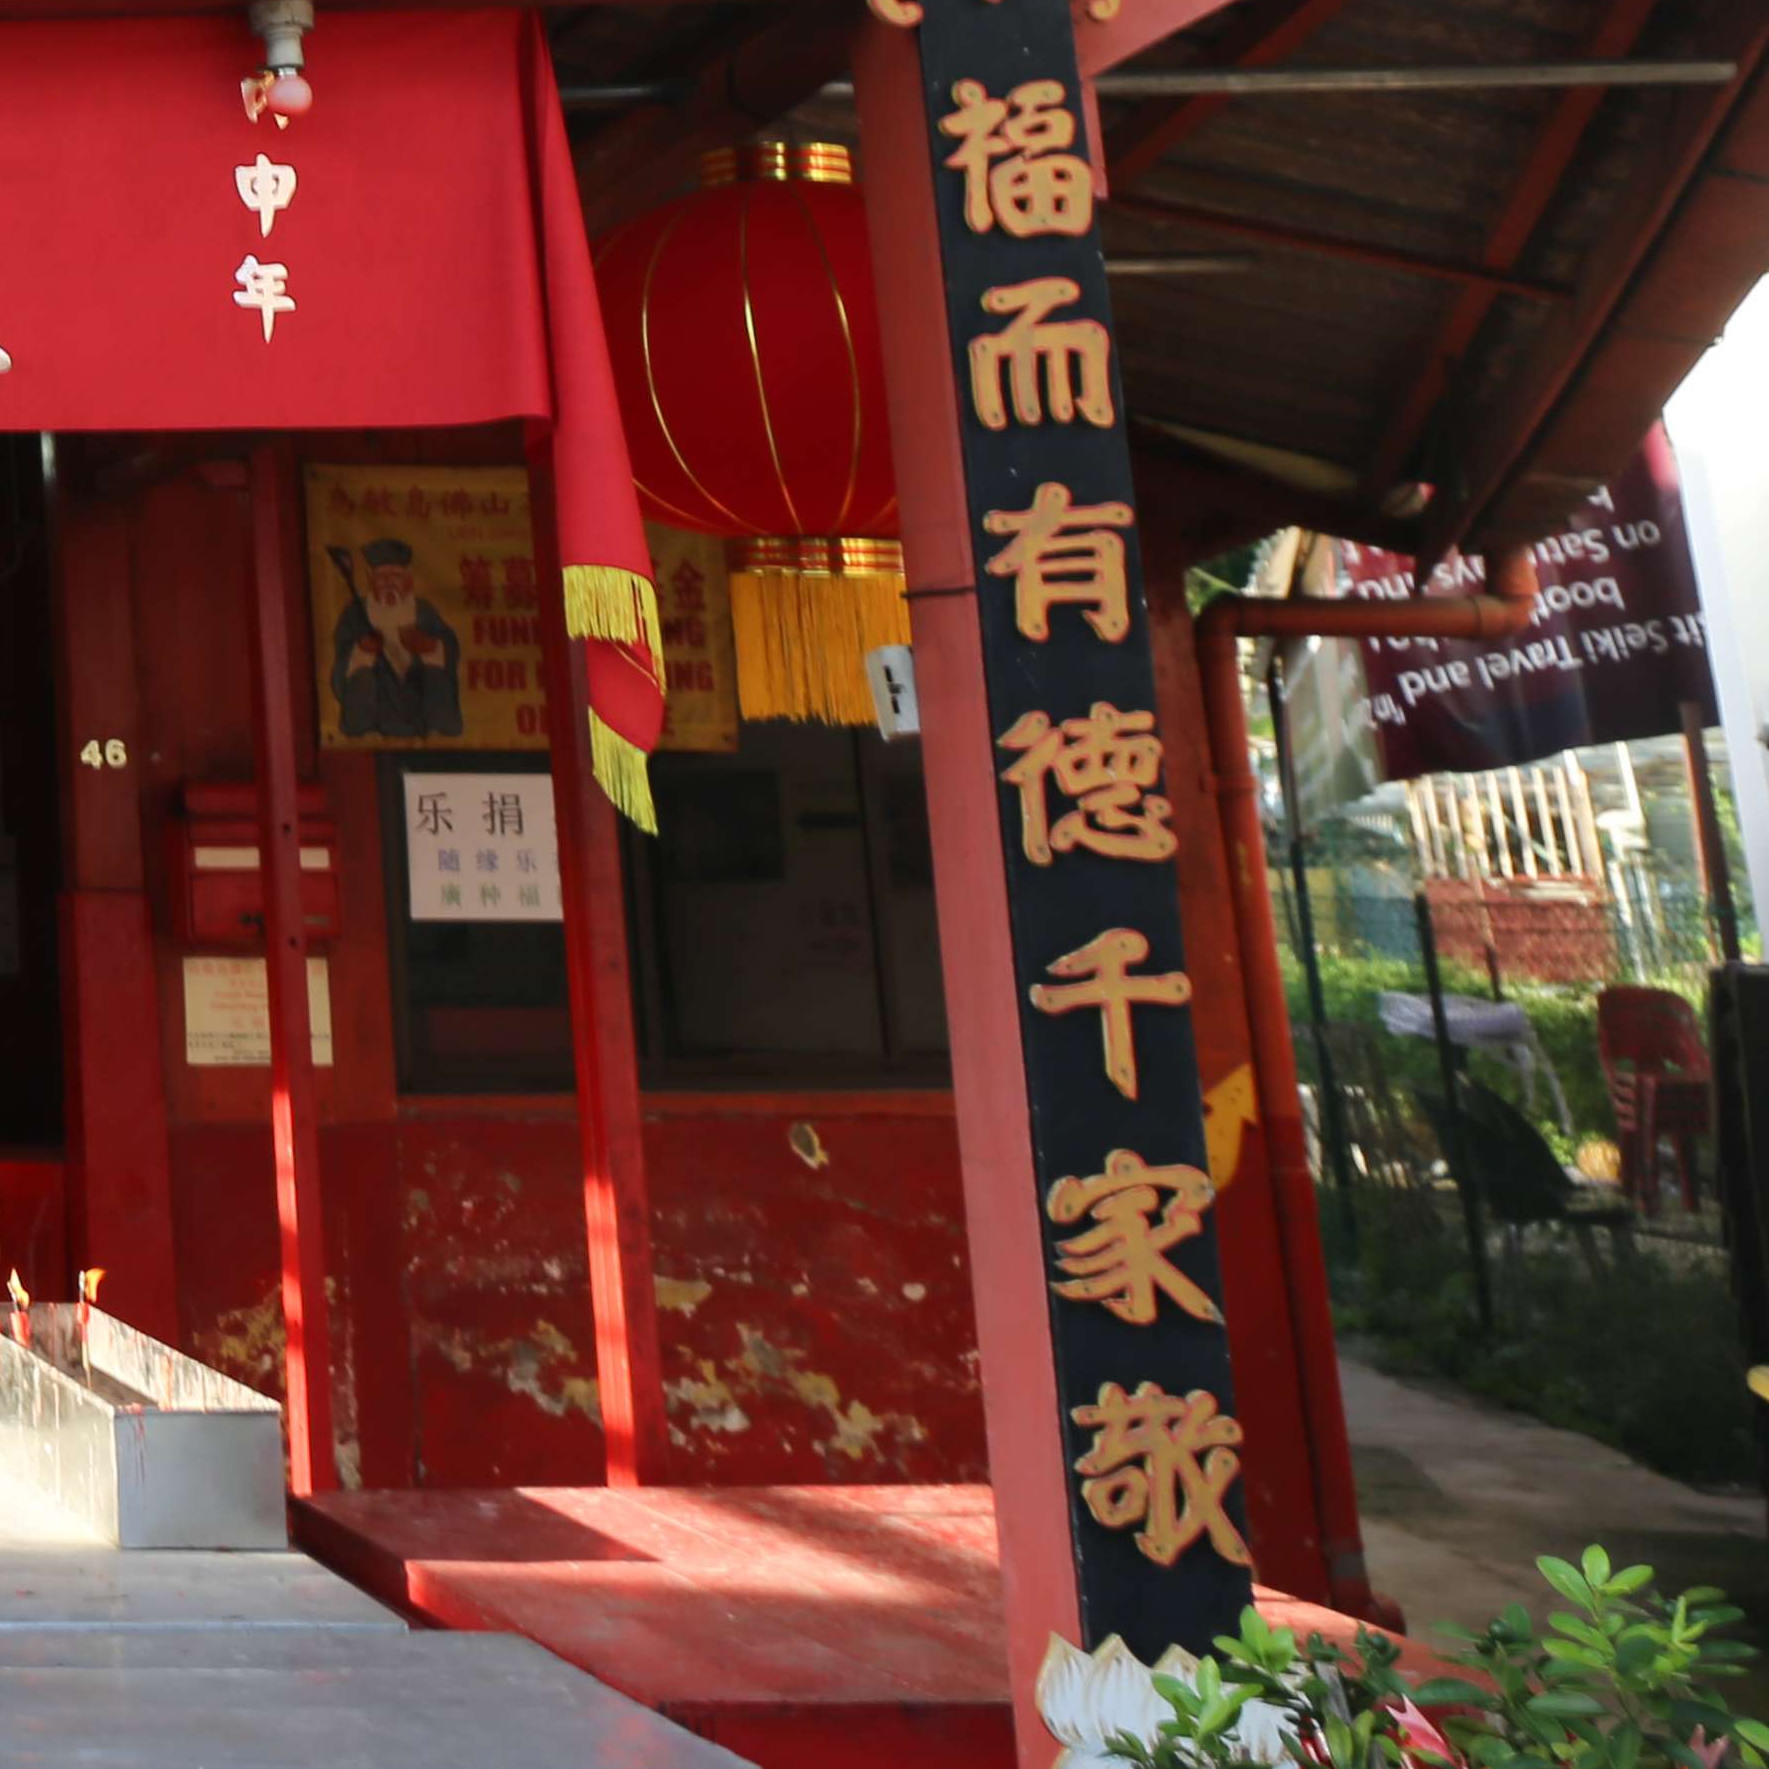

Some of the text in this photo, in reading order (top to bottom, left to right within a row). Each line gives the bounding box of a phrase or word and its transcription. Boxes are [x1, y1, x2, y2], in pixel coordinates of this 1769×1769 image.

[1612, 520, 1661, 551] on
[1473, 633, 1586, 691] Travel
[1579, 618, 1670, 666] Seiki
[1396, 659, 1472, 708] and
[80, 738, 128, 770] 46
[415, 791, 525, 837] 乐捐
[939, 78, 1253, 1570] 福而有德千家敬
